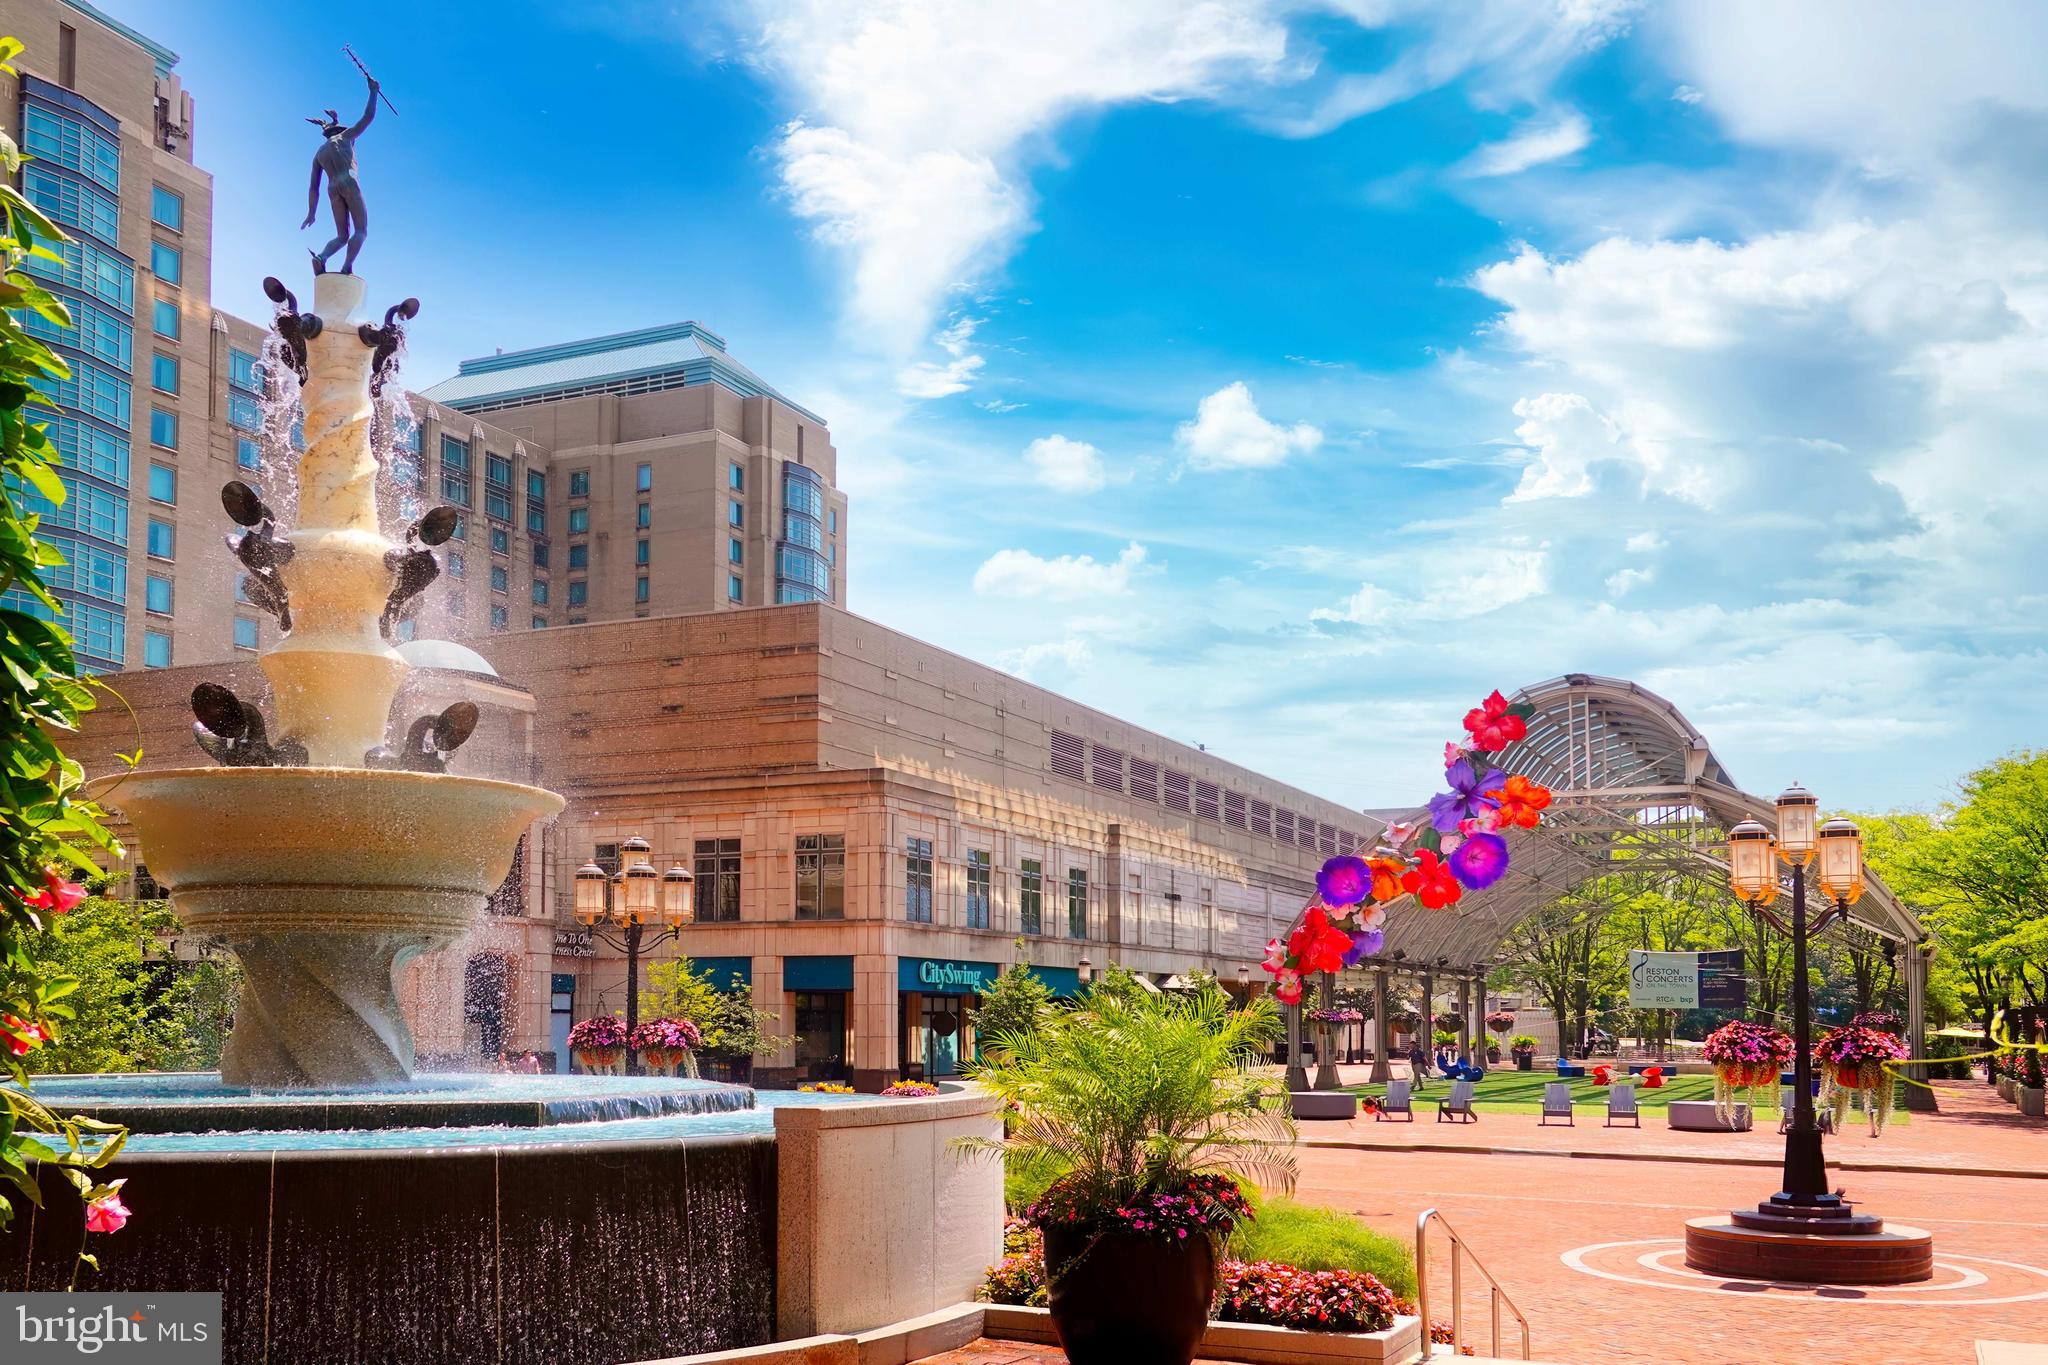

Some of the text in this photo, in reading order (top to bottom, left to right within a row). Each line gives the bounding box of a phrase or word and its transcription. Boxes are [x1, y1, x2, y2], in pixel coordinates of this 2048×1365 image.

[568, 933, 577, 944] To
[578, 933, 593, 945] One
[573, 946, 597, 957] Center
[920, 961, 981, 992] CitySwing
[1646, 968, 1680, 976] RESTON
[1646, 975, 1694, 983] CONCERTS
